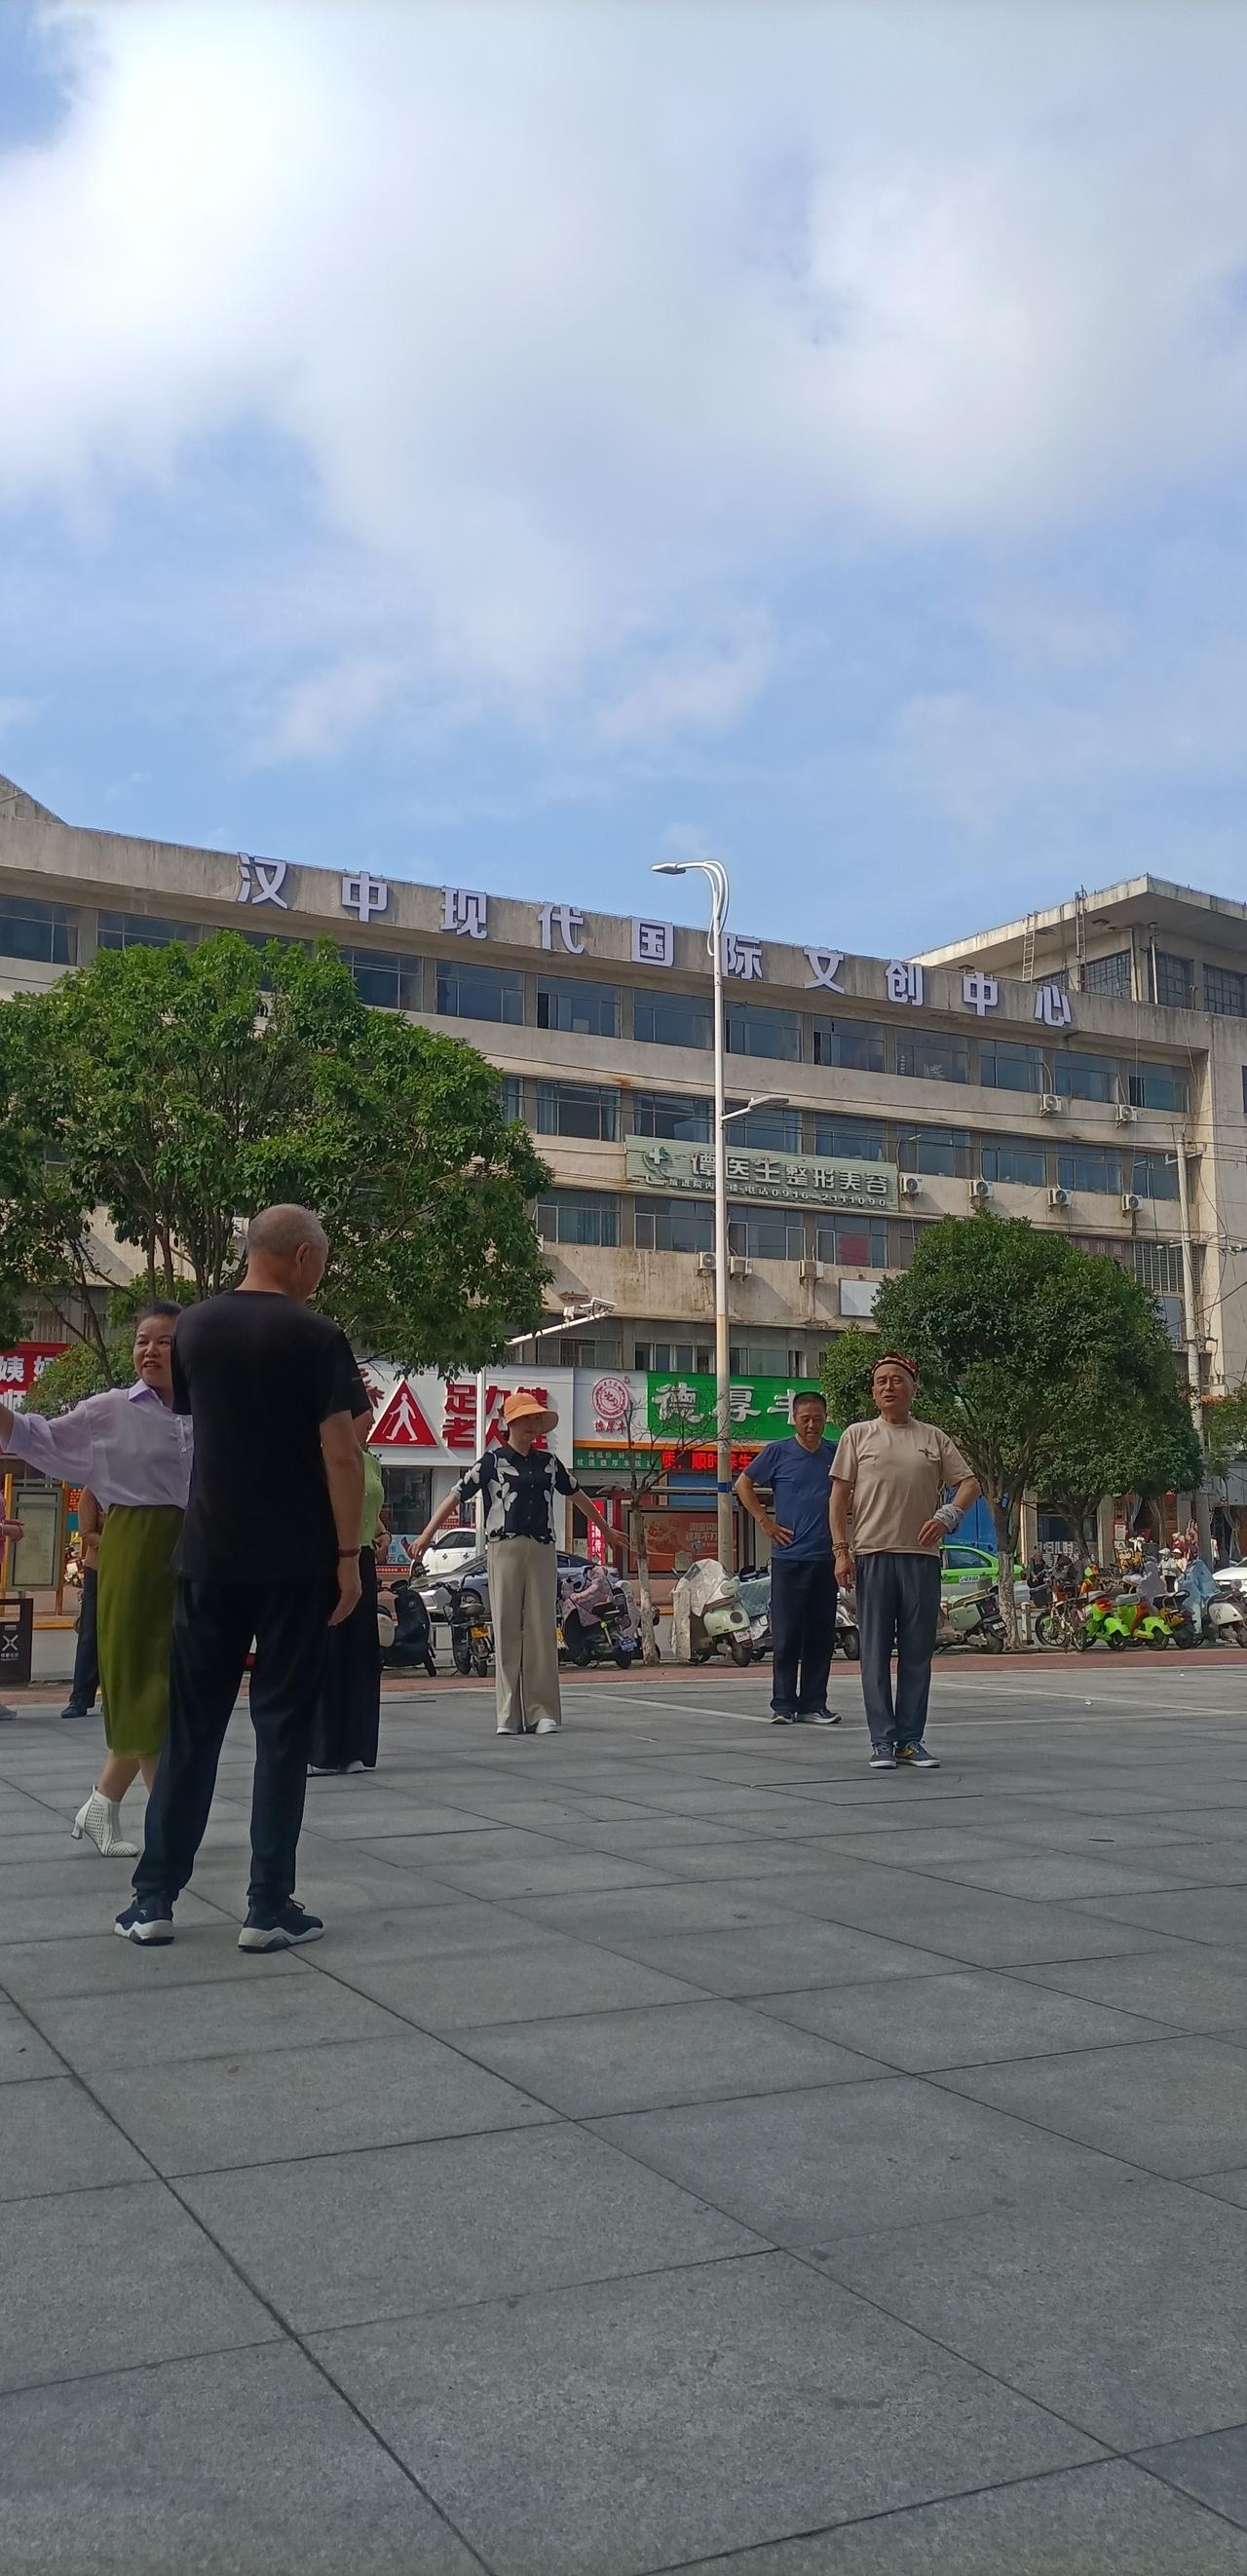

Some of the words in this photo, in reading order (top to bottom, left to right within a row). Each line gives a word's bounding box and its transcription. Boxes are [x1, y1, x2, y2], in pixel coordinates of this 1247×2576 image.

[236, 852, 1072, 1028] 汉中现代国际文创中心
